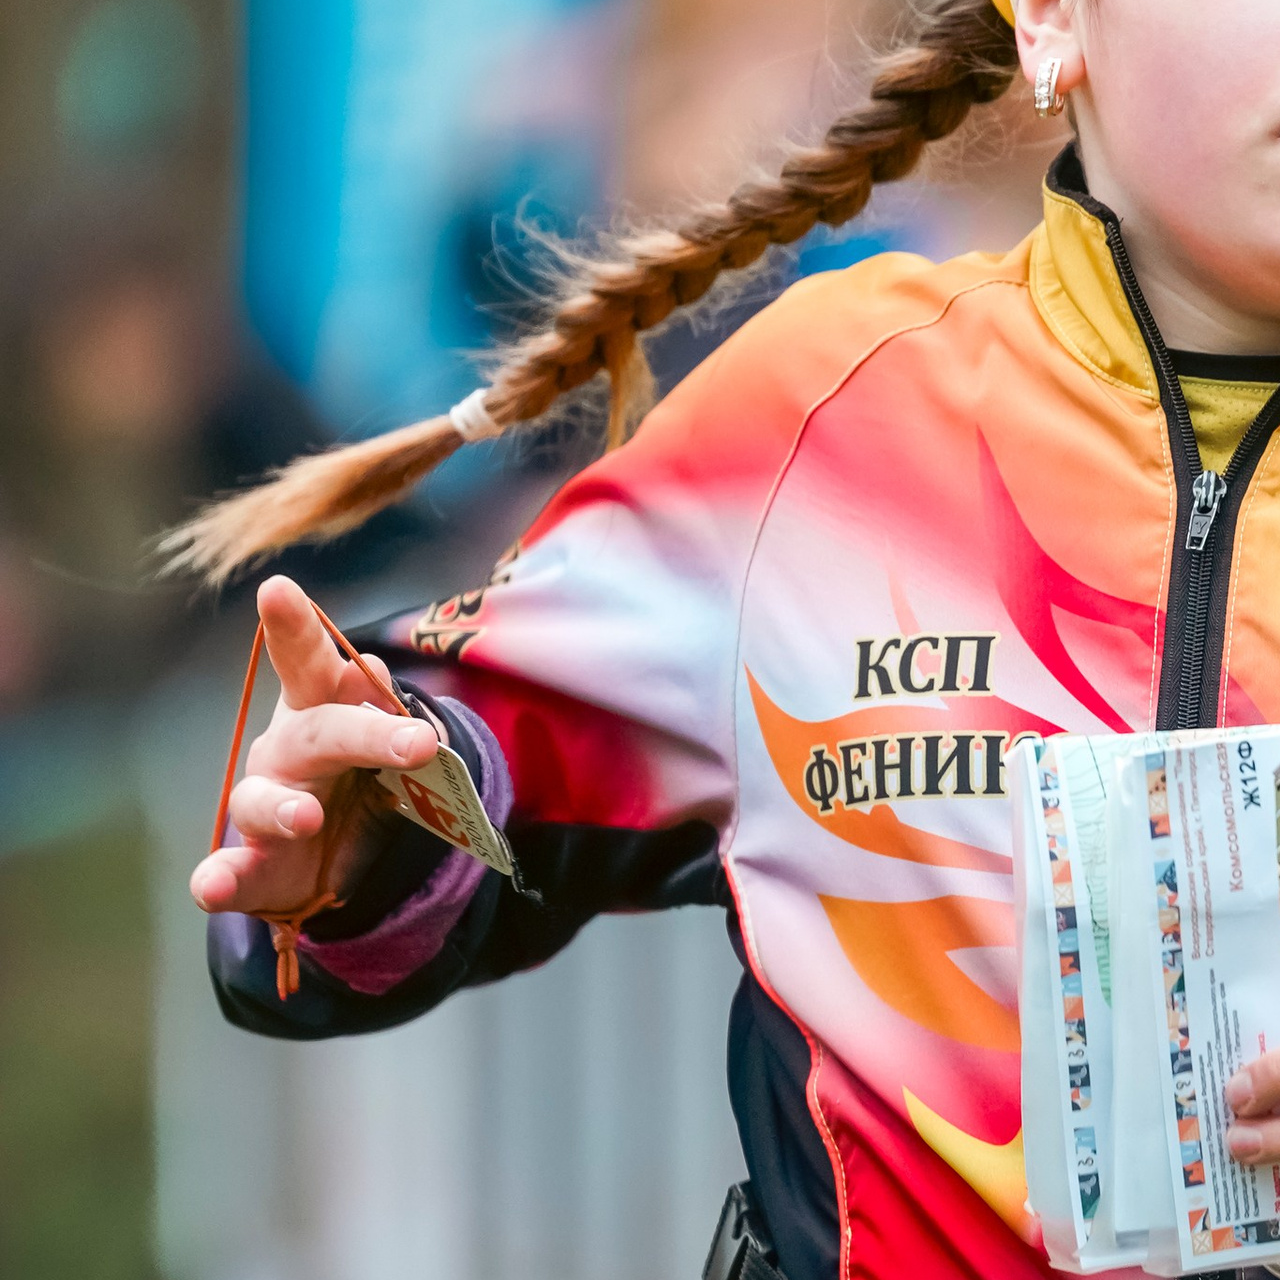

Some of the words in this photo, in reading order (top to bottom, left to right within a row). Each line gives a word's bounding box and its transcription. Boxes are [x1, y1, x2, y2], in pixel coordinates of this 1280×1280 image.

[854, 636, 996, 699] КСП
[1237, 741, 1261, 810] Ж12Ф
[1216, 742, 1242, 892] Комсомольская
